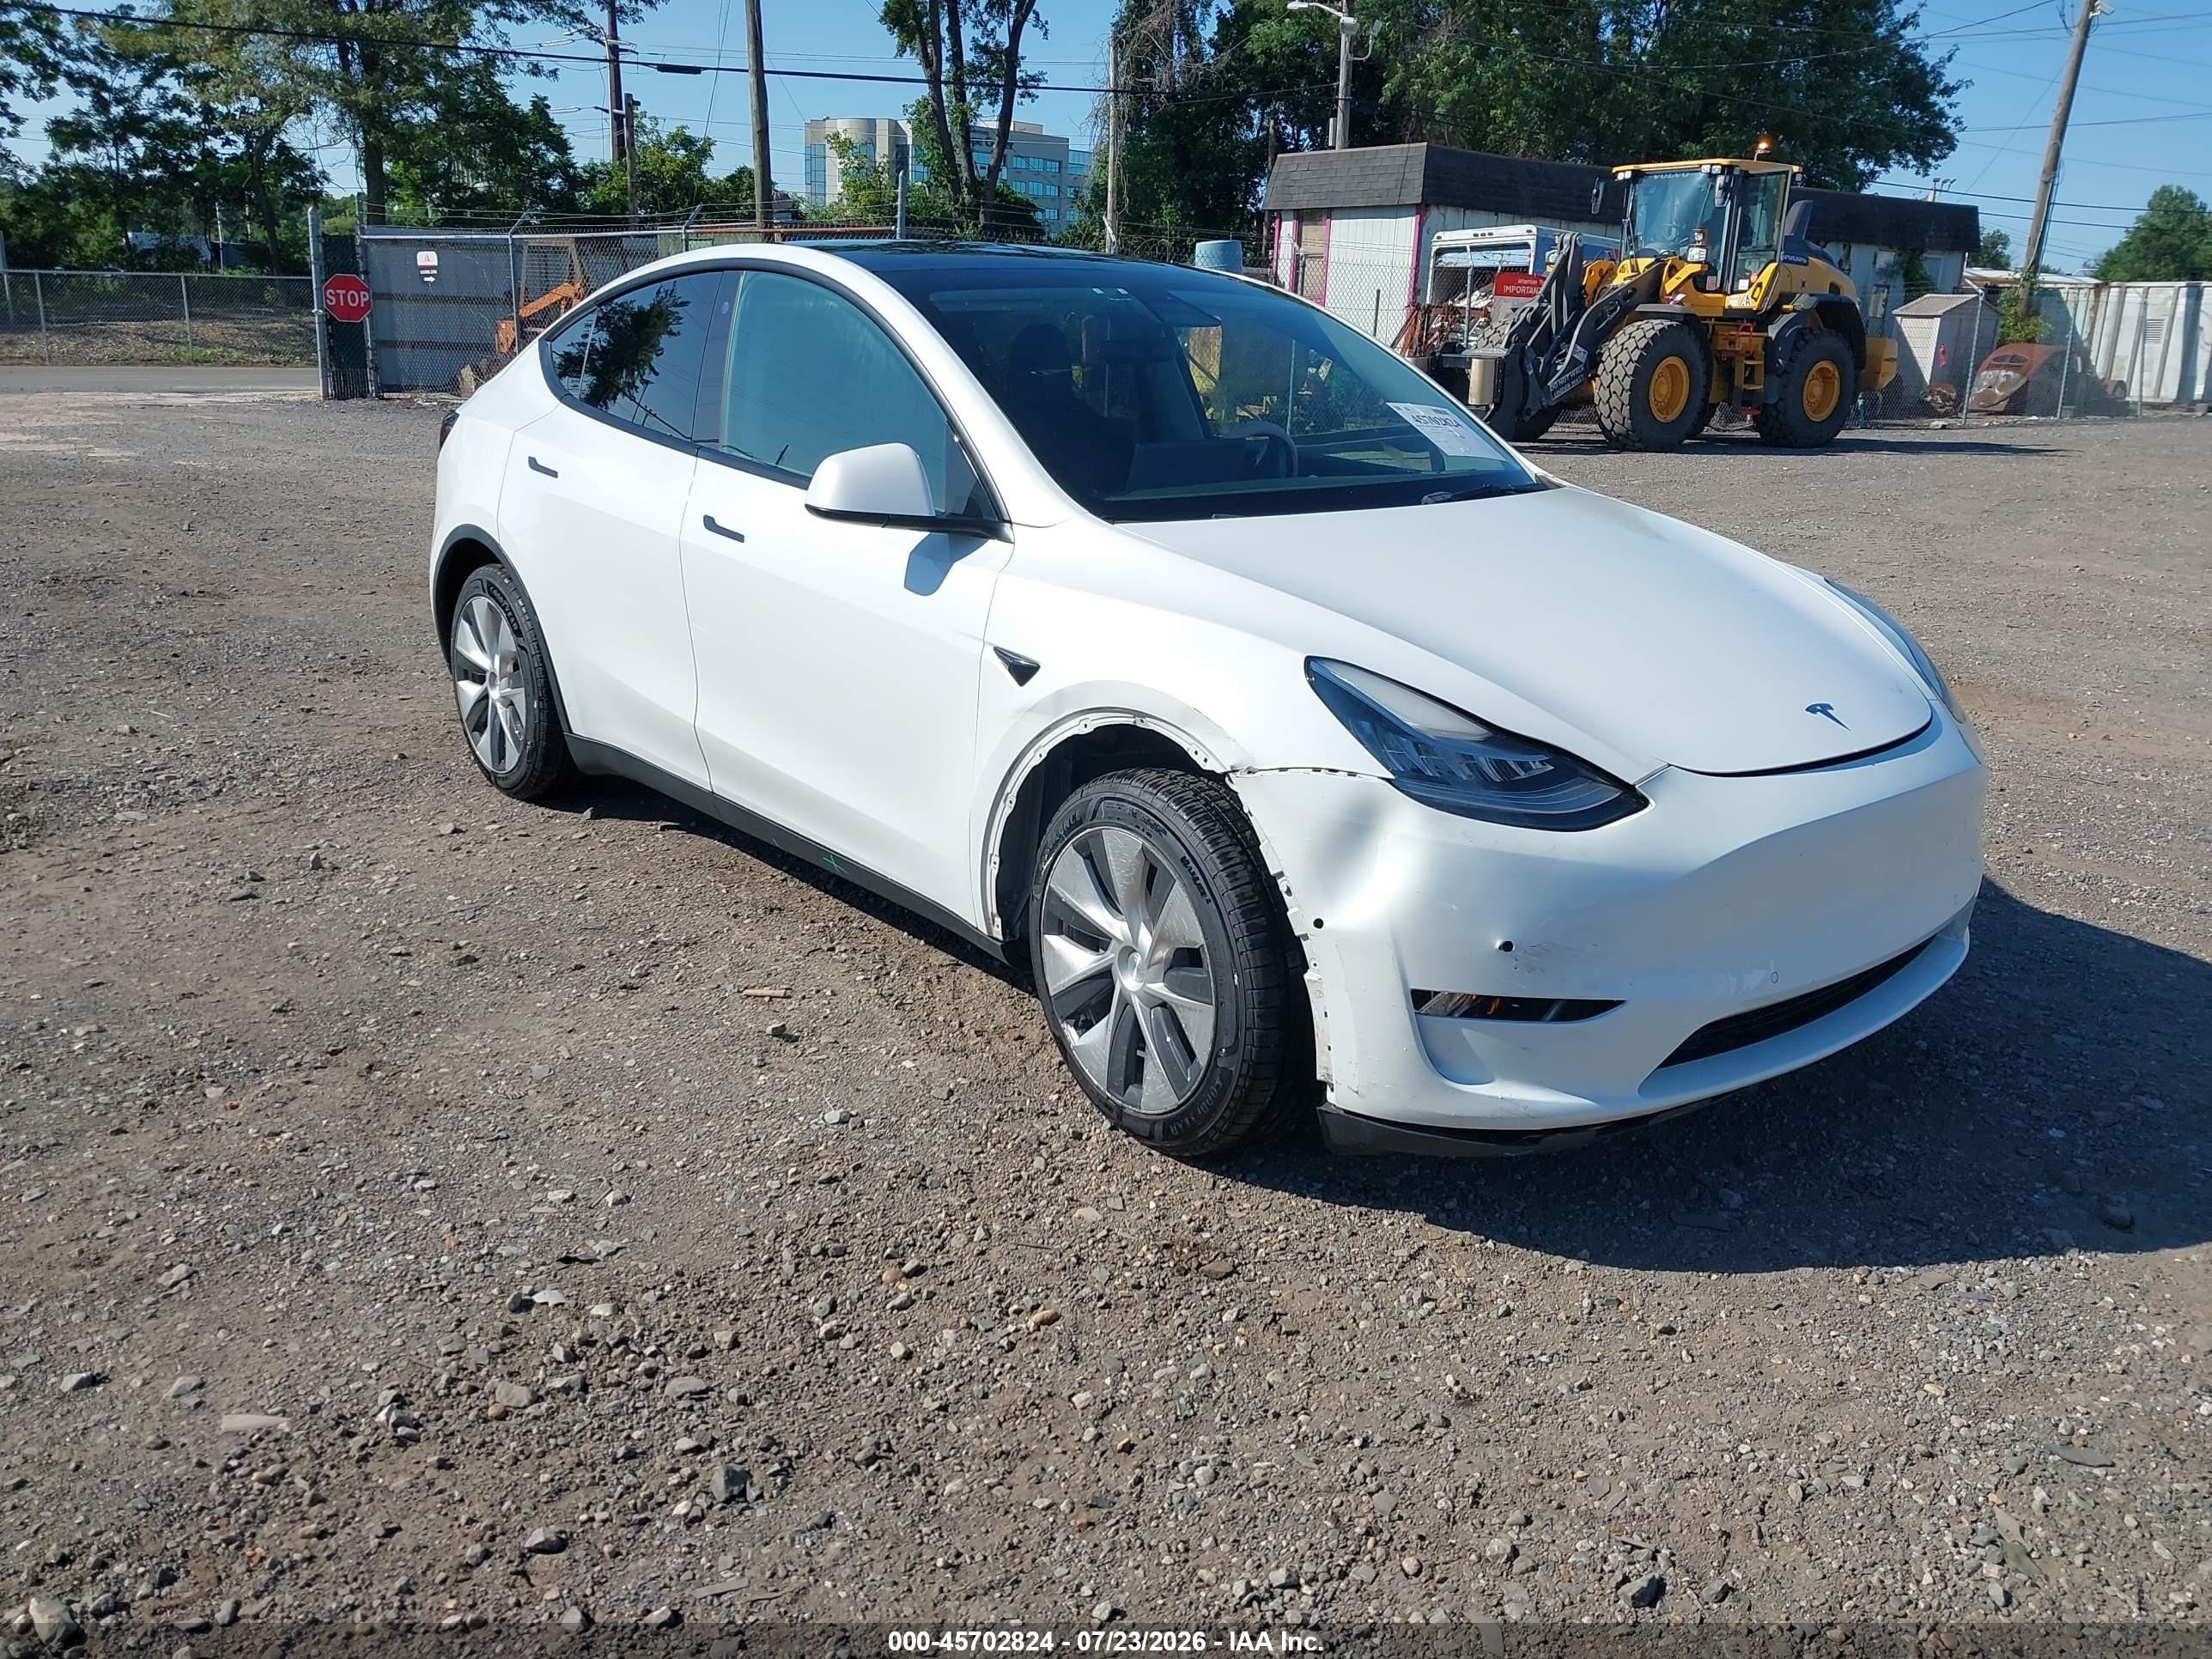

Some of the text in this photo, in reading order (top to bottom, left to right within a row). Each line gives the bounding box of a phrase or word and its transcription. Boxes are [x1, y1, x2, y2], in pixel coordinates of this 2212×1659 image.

[326, 289, 369, 307] STOP
[1549, 383, 1559, 392] DO
[1559, 374, 1570, 386] NOT
[1554, 383, 1571, 397] UNDER
